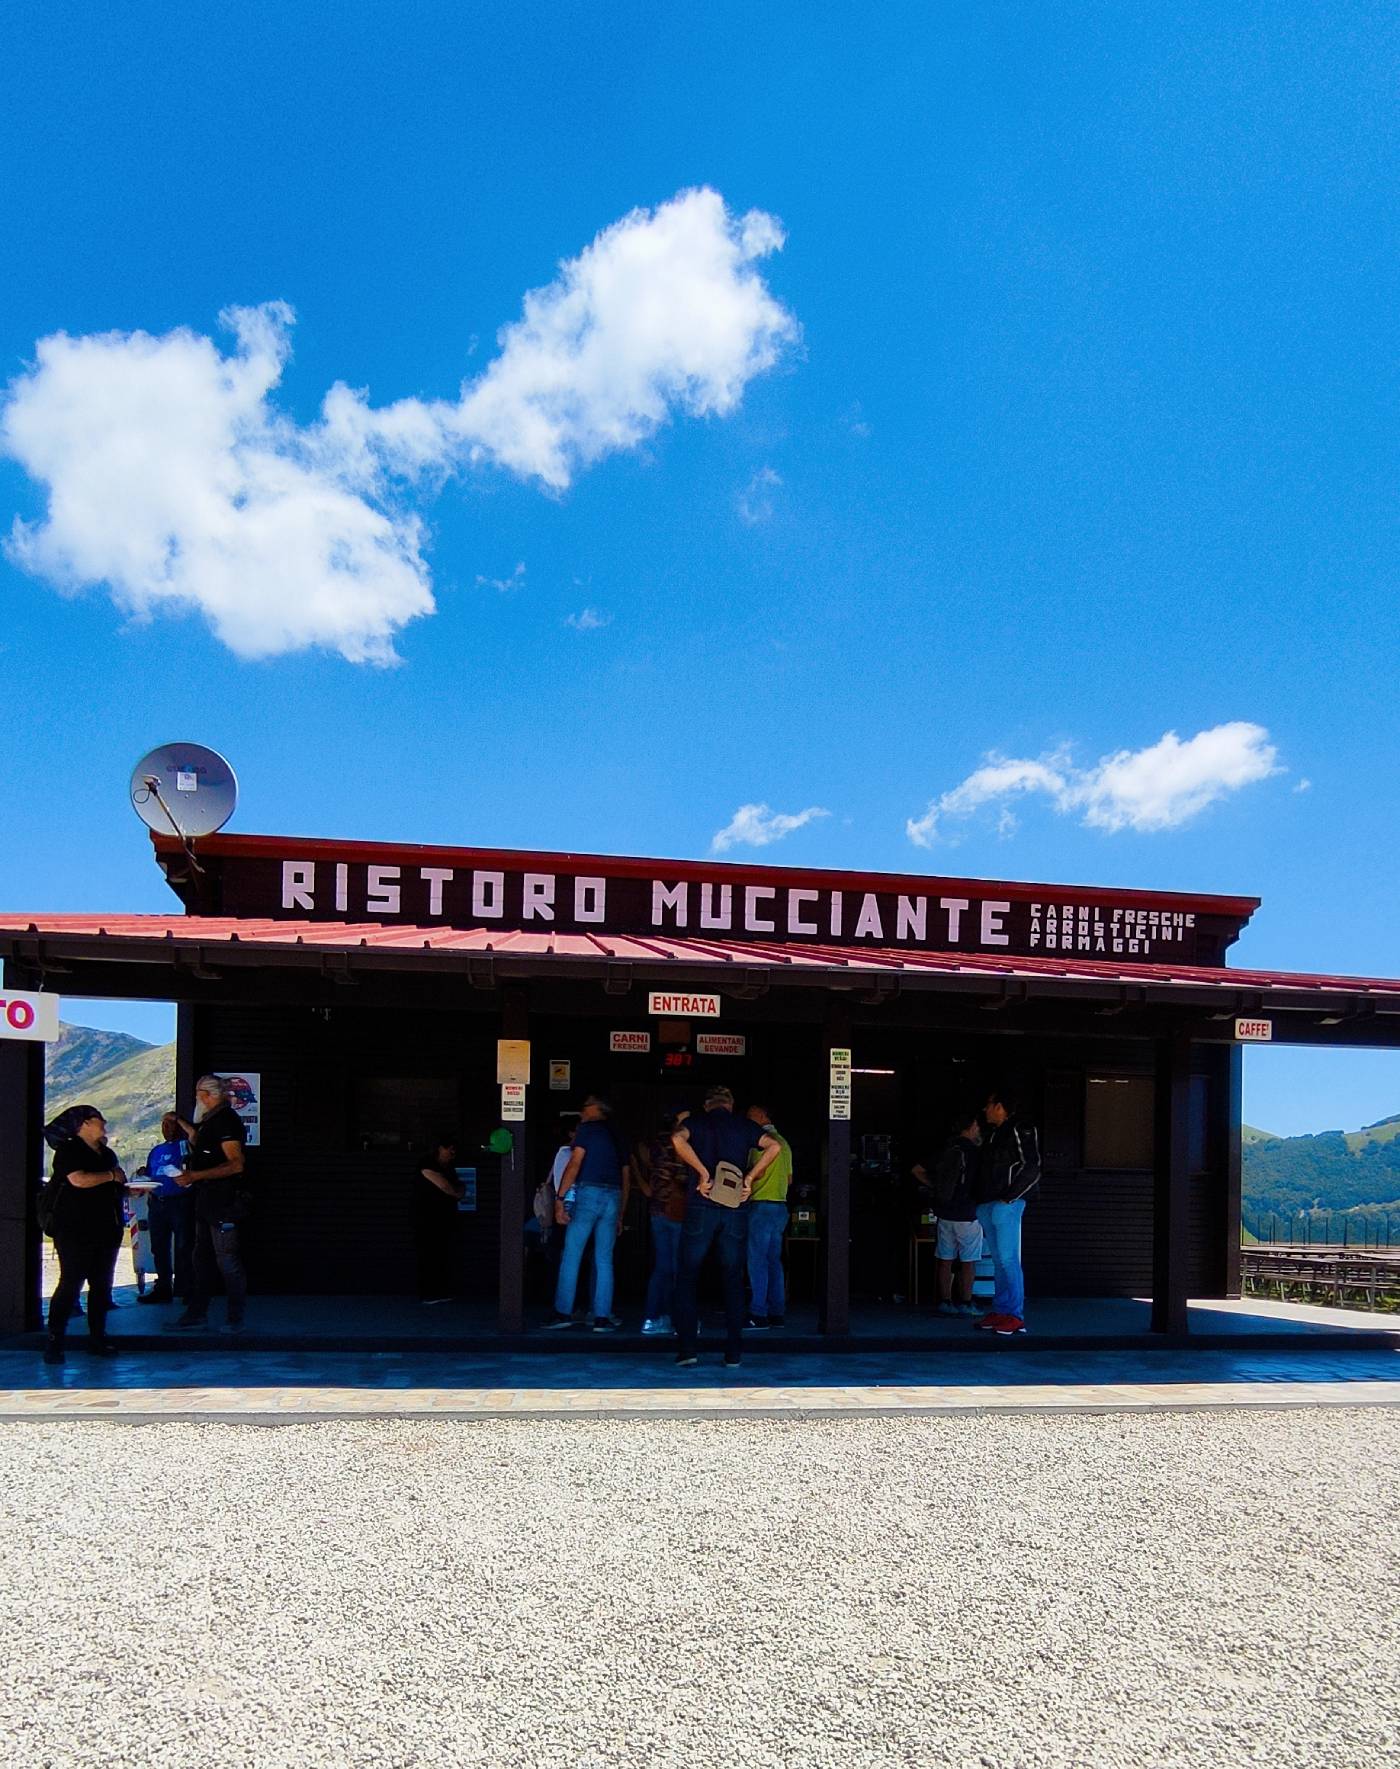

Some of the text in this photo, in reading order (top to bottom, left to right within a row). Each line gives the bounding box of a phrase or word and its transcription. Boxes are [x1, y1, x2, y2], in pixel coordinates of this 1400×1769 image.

[282, 860, 1011, 946] RISTORO MUCCIANTE
[1030, 903, 1196, 928] CARNI FRESCHE
[1030, 918, 1183, 942] ARROSTICINI
[1029, 933, 1150, 954] FORMAGGI
[652, 996, 717, 1014] ENTRATA
[612, 1043, 648, 1051] FRESCHE
[613, 1033, 649, 1044] CARNI
[699, 1036, 744, 1046] ALIMENTARI
[704, 1045, 739, 1054] BEVANDE
